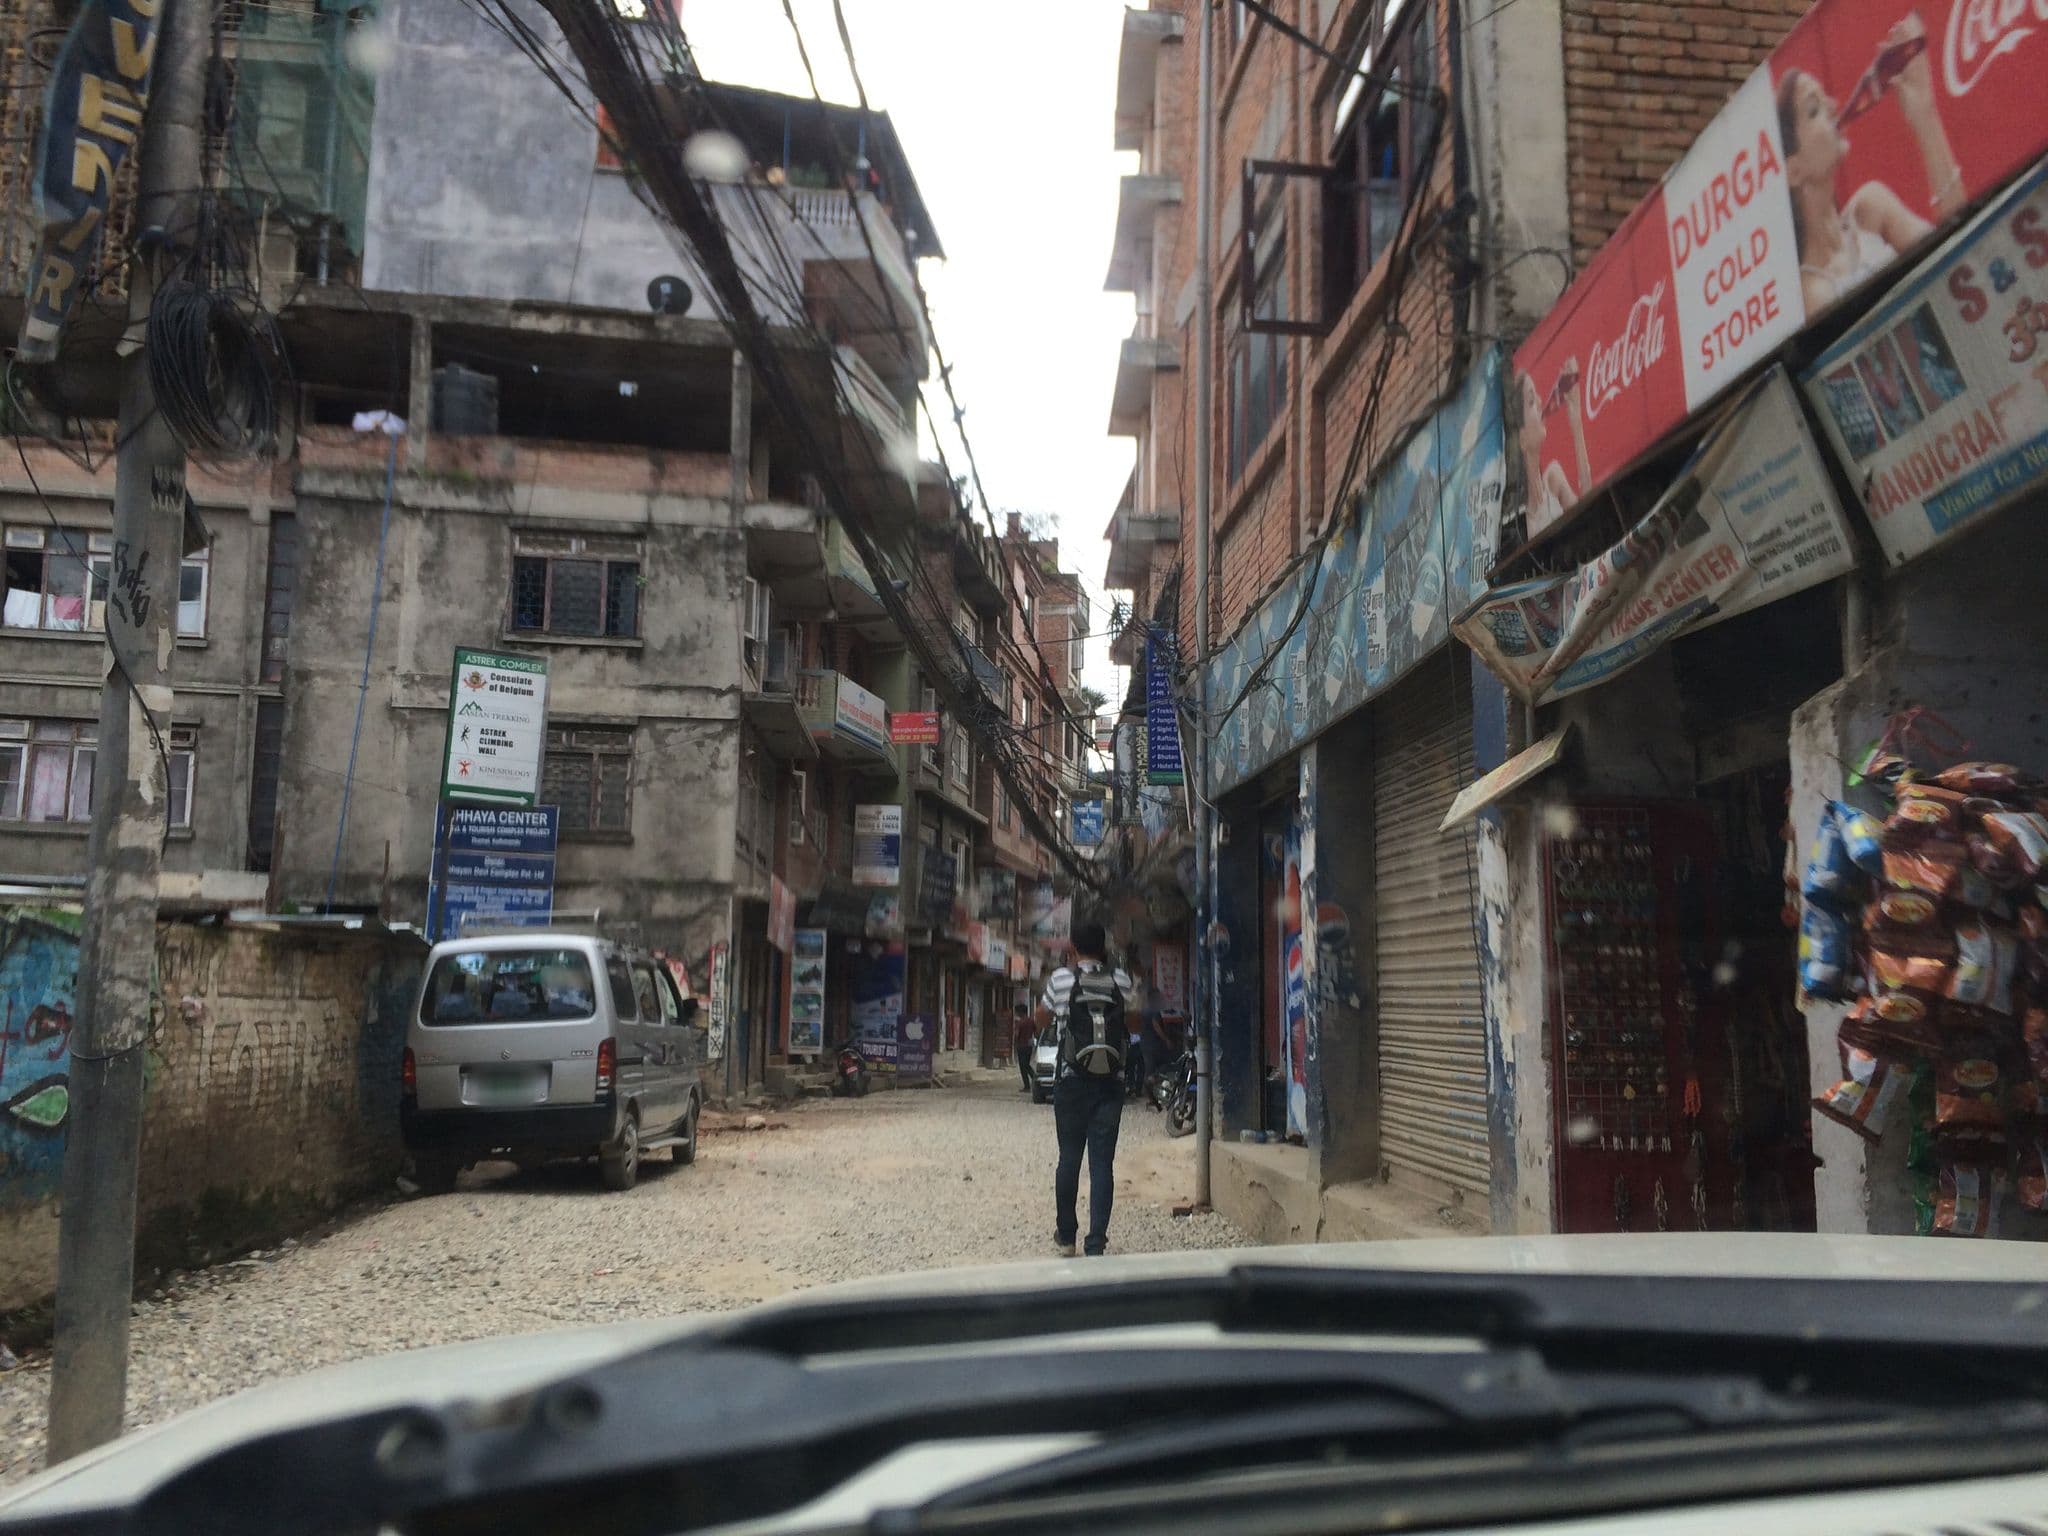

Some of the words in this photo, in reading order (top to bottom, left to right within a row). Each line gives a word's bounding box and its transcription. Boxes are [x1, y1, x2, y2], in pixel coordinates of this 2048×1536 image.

[1672, 129, 1780, 269] DURGA
[1704, 226, 1769, 306] COLD
[1701, 279, 1780, 370] STORE
[1653, 543, 1740, 609] CENTER
[465, 655, 497, 667] ASTREK
[499, 661, 542, 672] COMPLEX
[490, 673, 533, 686] Consulate
[489, 684, 498, 692] of
[499, 685, 534, 696] Belgium
[480, 728, 507, 738] ASTREK
[478, 747, 497, 756] WALL
[479, 738, 514, 748] CLIMBING
[453, 808, 496, 824] HHAYA
[499, 811, 548, 826] CENTER
